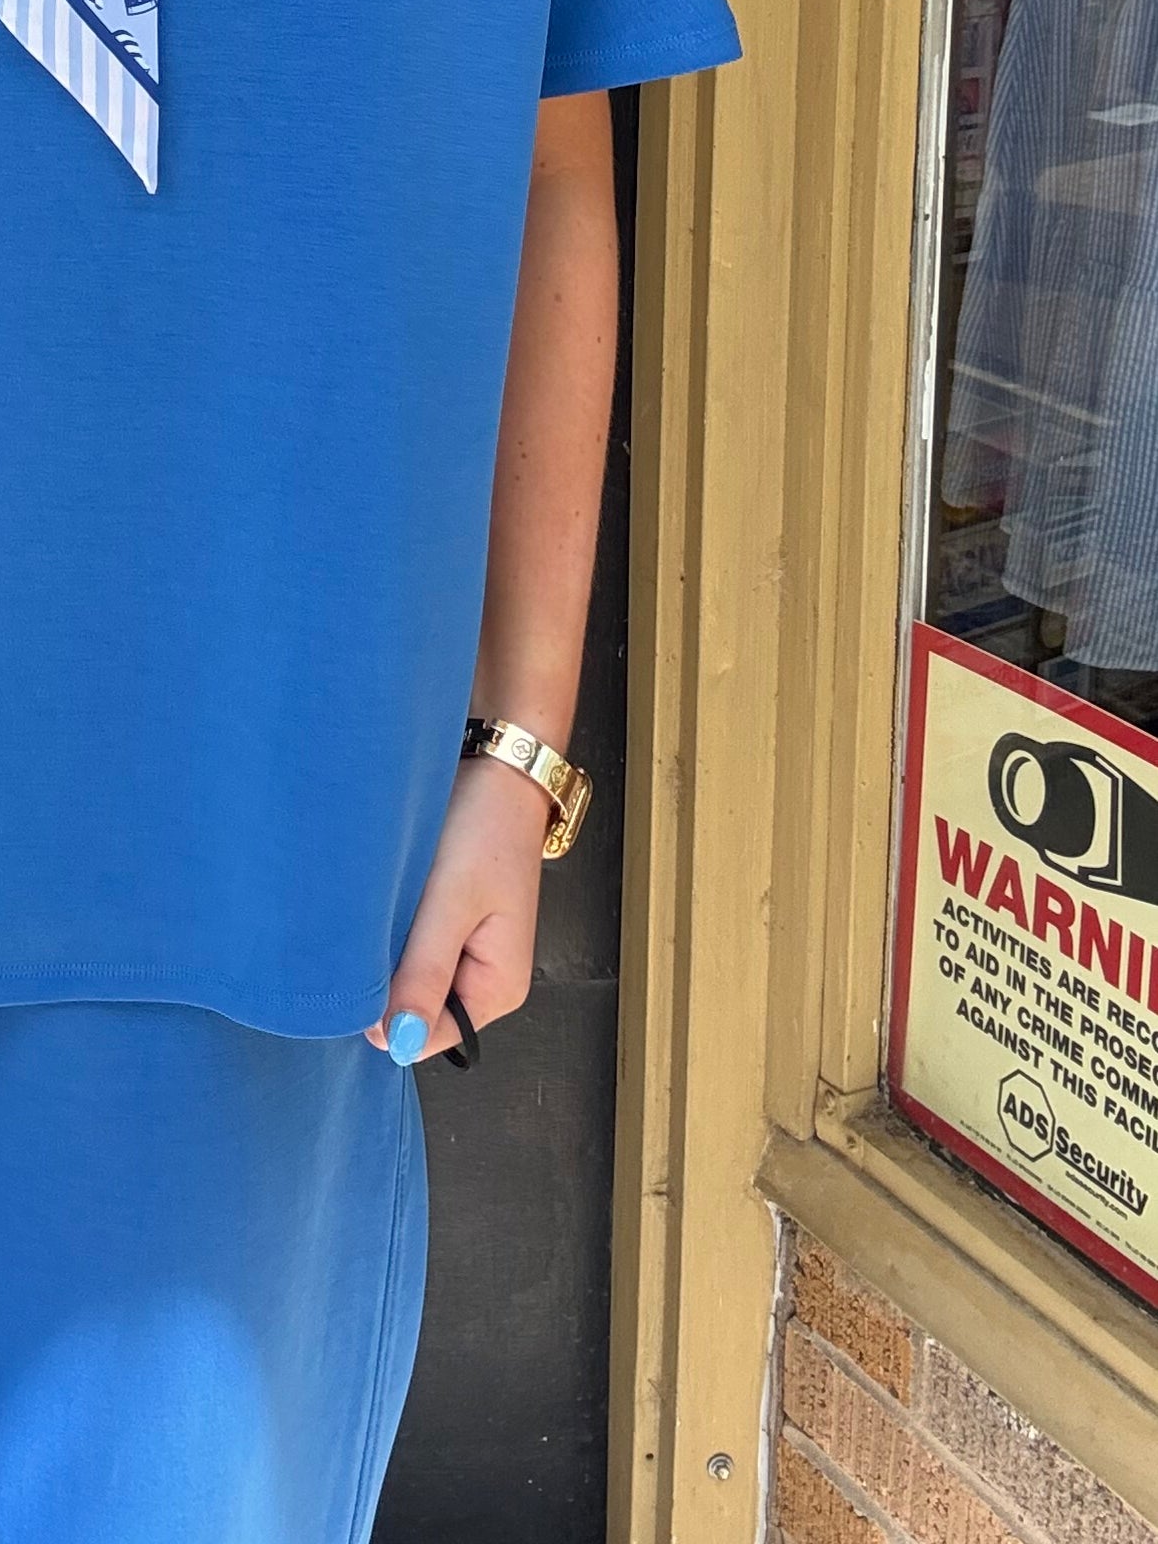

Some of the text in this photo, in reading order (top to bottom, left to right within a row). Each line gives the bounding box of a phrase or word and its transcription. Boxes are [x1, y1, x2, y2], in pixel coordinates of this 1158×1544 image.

[934, 814, 1158, 1016] WARNI
[942, 897, 1052, 980] ACTIVITIES
[1057, 969, 1100, 1013] ARE
[933, 918, 960, 951] TO
[965, 942, 999, 976] AID
[1006, 965, 1026, 996] IN
[1033, 982, 1074, 1028] THE
[939, 955, 966, 984] OF
[970, 976, 1012, 1015] ANY
[1017, 1006, 1084, 1067] CRIME
[956, 997, 1044, 1069] AGAINST
[1050, 1058, 1098, 1108] THIS
[1003, 1092, 1049, 1141] ADS
[1055, 1126, 1148, 1216] Security
